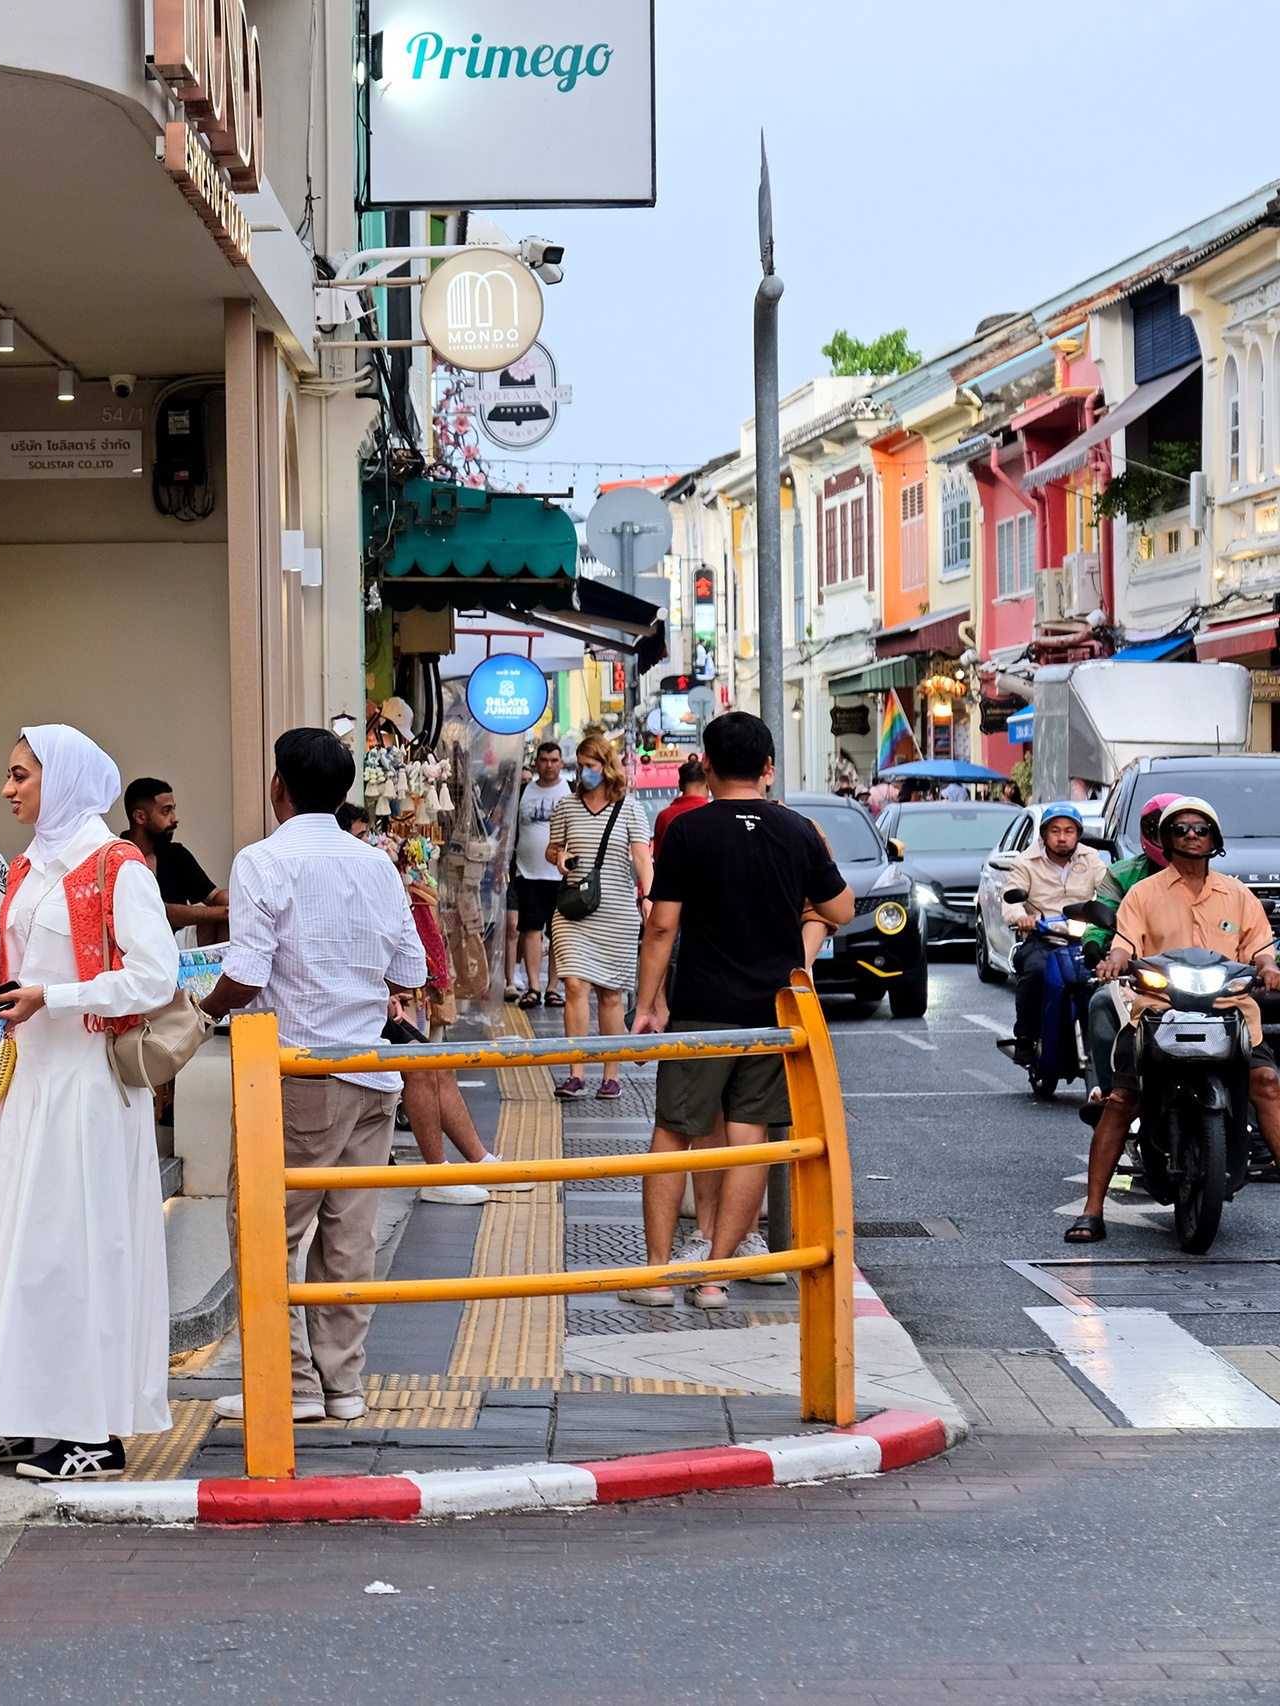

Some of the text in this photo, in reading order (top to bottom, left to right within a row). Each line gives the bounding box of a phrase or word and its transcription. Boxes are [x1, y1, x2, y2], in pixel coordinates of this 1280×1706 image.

[406, 31, 614, 92] Primego
[448, 329, 519, 344] MONDO
[473, 388, 563, 402] KORRAKANG
[499, 406, 536, 414] PHUKET
[10, 440, 42, 452] บริษัท
[100, 437, 131, 451] จำกัด
[28, 460, 74, 470] SOLISTAR
[485, 696, 528, 706] GELATO
[484, 706, 530, 716] JUNKIES
[659, 750, 679, 758] TAXI
